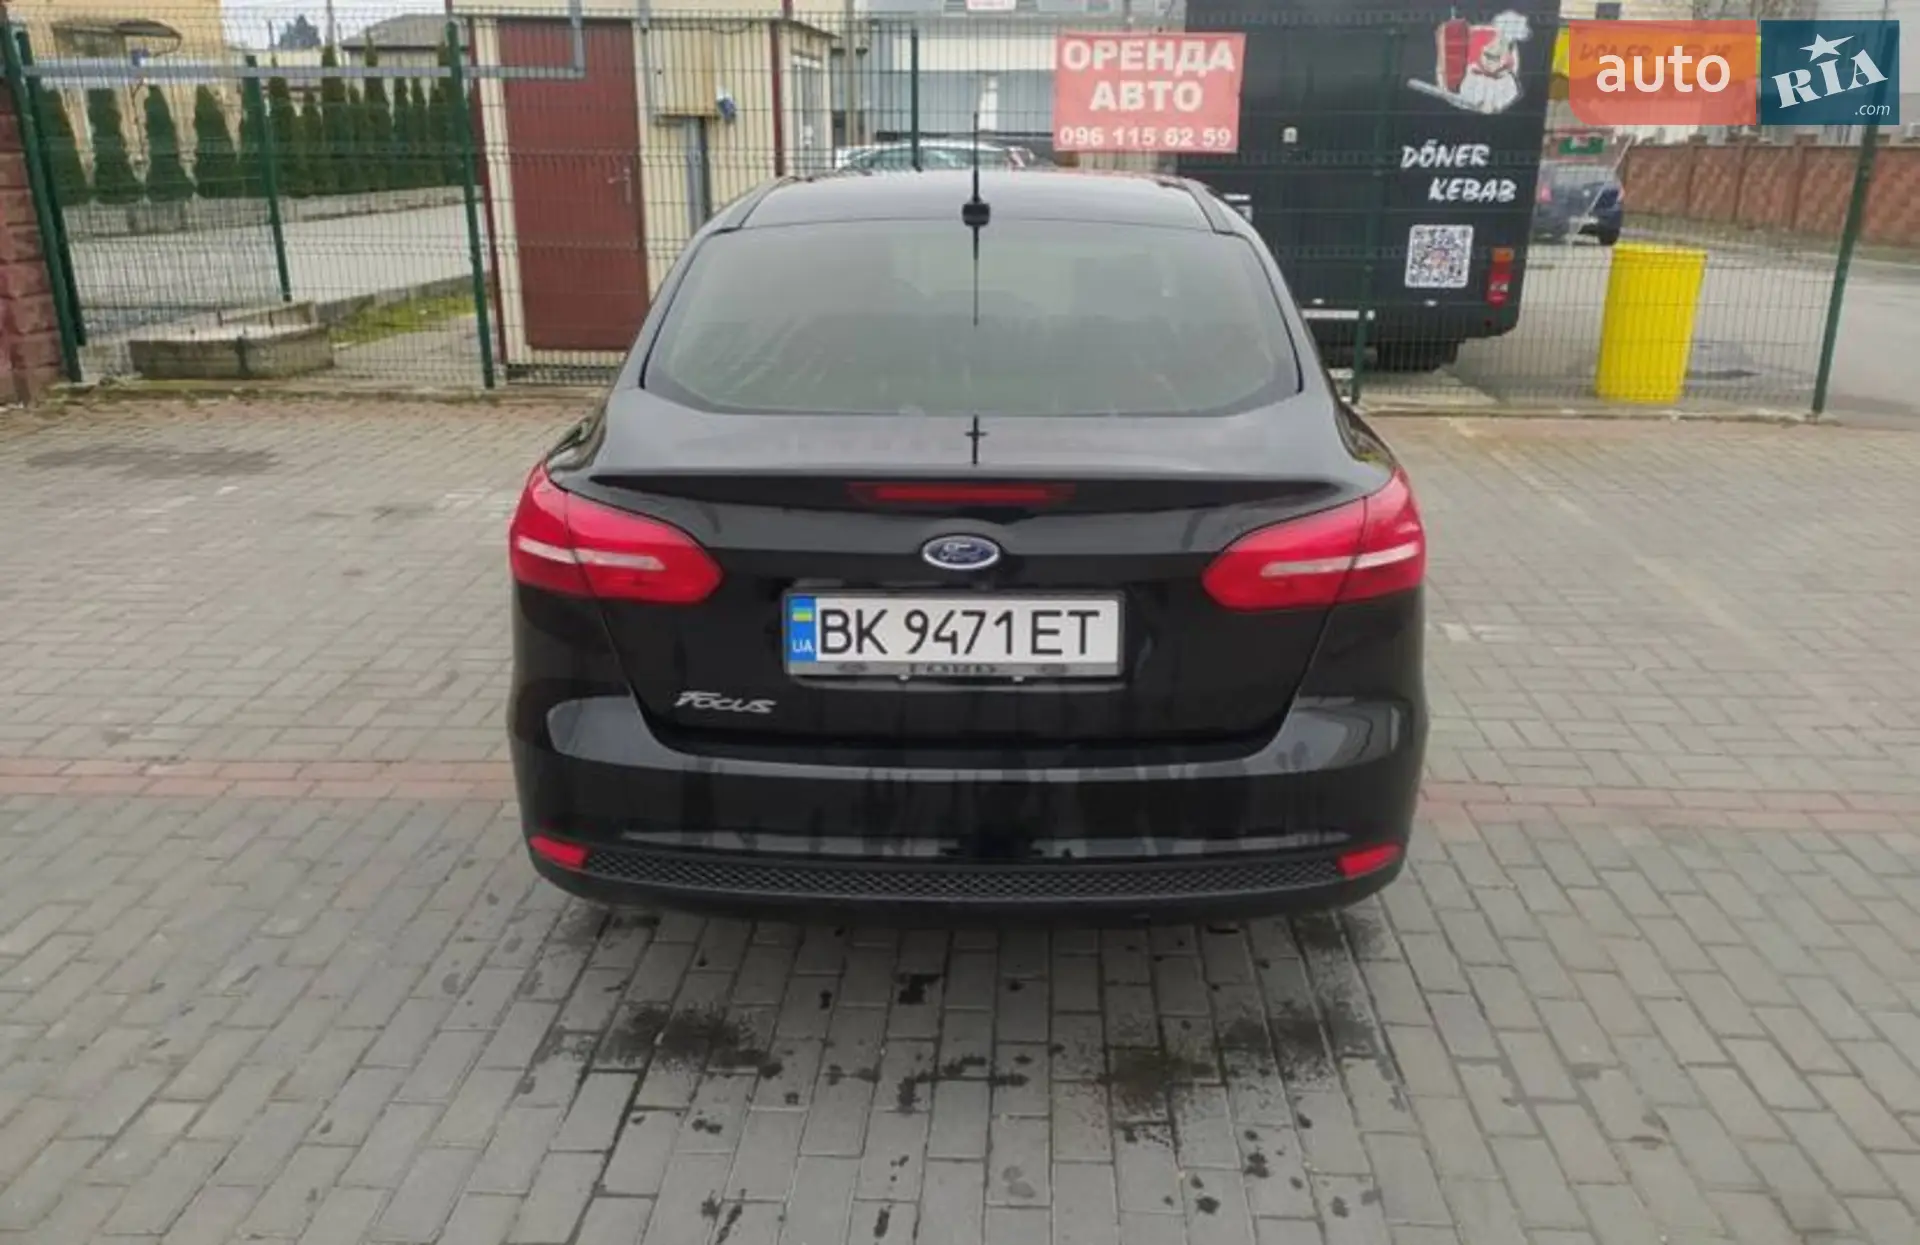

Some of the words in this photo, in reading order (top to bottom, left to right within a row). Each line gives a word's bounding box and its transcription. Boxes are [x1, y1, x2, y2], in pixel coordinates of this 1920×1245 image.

[1062, 39, 1235, 77] ОРЕНДА
[1089, 79, 1203, 112] АВТО
[1059, 126, 1104, 146] 096
[1112, 126, 1157, 146] 115
[1163, 126, 1194, 146] 62
[1202, 126, 1232, 147] 59
[1400, 139, 1490, 169] DÖNER
[1428, 177, 1518, 202] KEBAB
[792, 640, 813, 653] UA
[819, 609, 888, 655] BK
[904, 608, 1014, 655] 9471
[1030, 609, 1100, 655] ET
